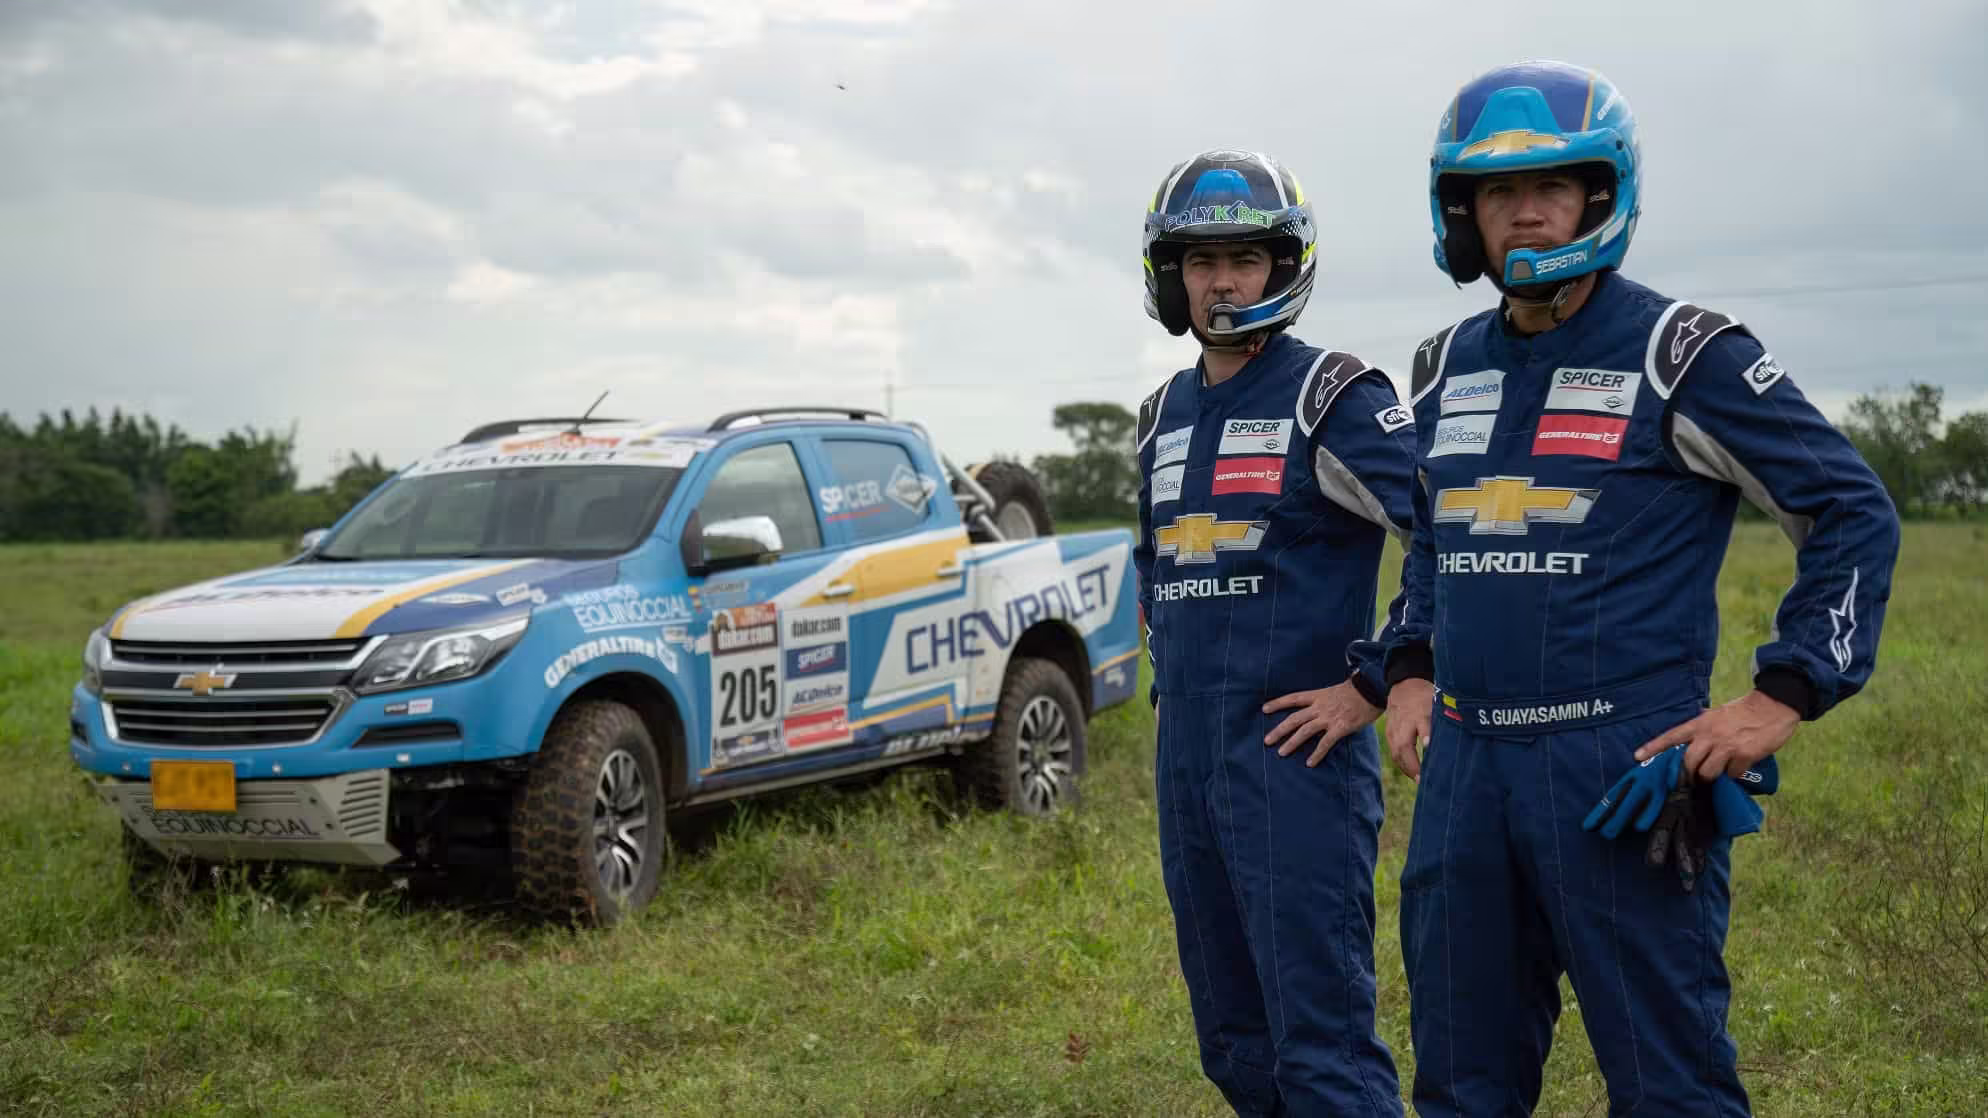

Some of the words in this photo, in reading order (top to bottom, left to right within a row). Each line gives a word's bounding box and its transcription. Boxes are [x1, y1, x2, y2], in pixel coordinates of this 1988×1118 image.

[1536, 251, 1588, 275] SEBASTIAN
[1448, 384, 1499, 398] ACDelco
[1560, 371, 1625, 388] SPICER
[1228, 422, 1280, 433] SPICER
[820, 481, 883, 514] SPICER
[1439, 552, 1589, 574] CHEVROLET
[906, 564, 1110, 676] CHEVROLET
[720, 664, 777, 727] 205
[1478, 709, 1490, 725] S.
[1492, 701, 1589, 725] GUAYASAMIN
[1591, 699, 1614, 716] A+
